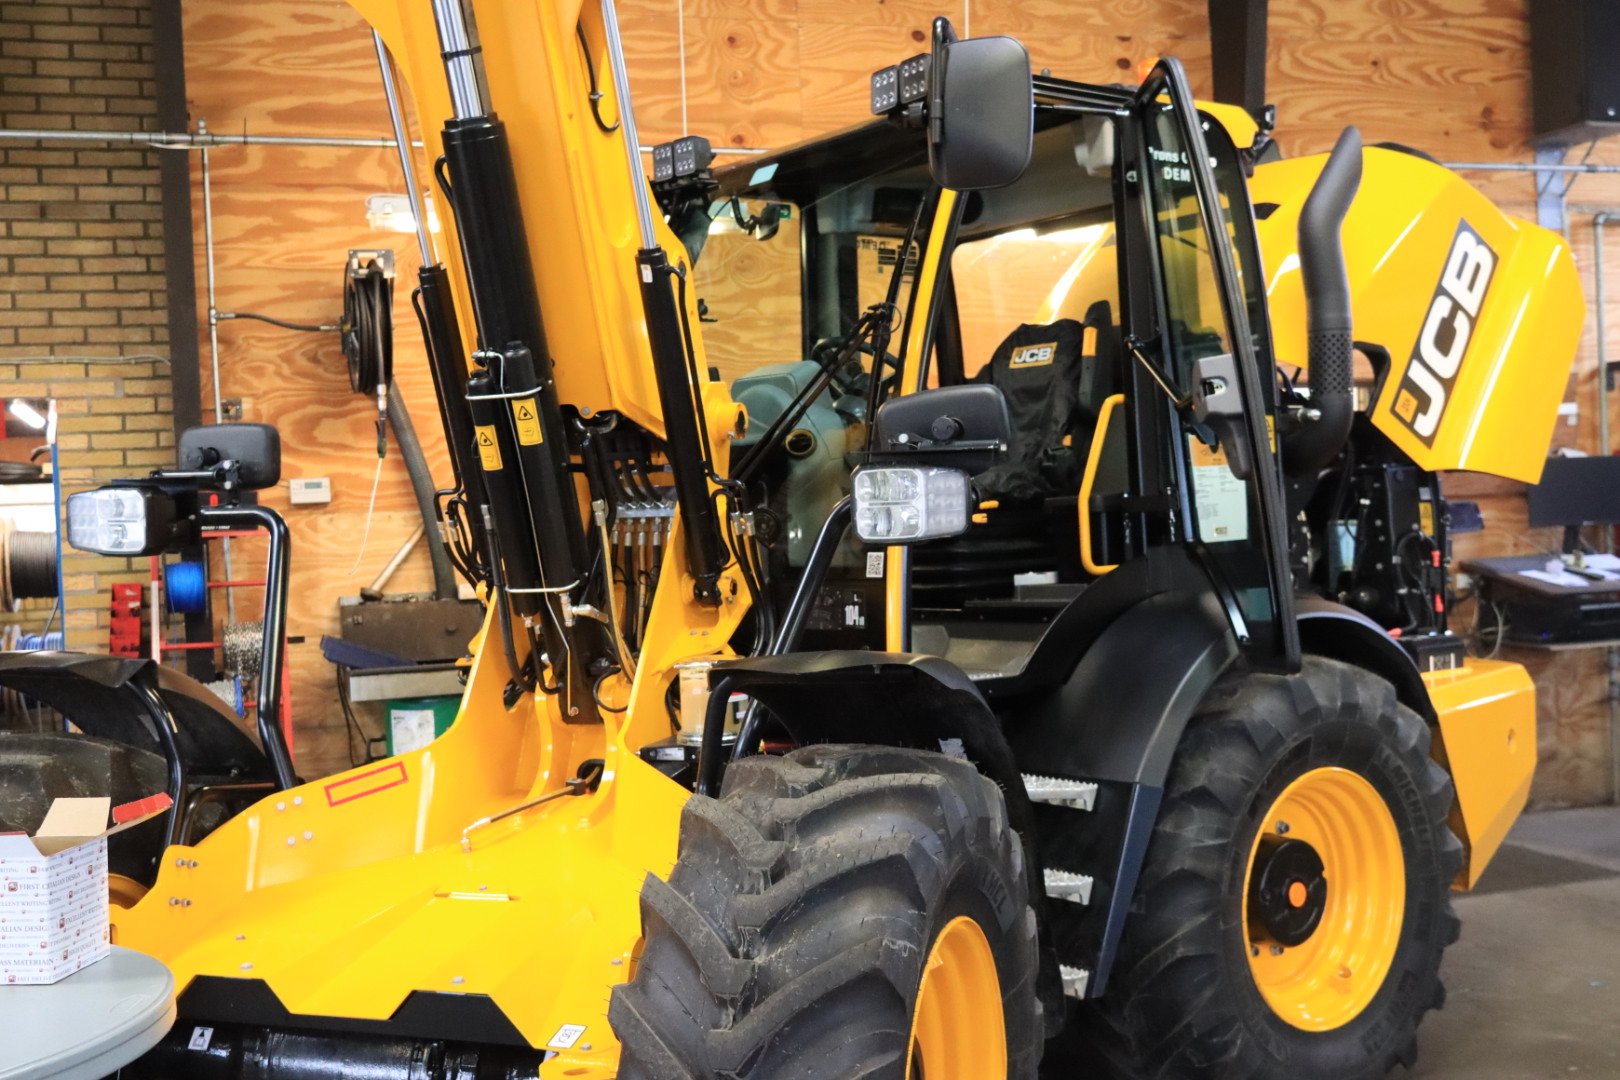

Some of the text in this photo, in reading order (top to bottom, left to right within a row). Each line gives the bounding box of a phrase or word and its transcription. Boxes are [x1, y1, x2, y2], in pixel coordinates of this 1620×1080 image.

[1408, 231, 1493, 437] JCB
[1014, 347, 1052, 363] JCB
[845, 605, 860, 625] 104
